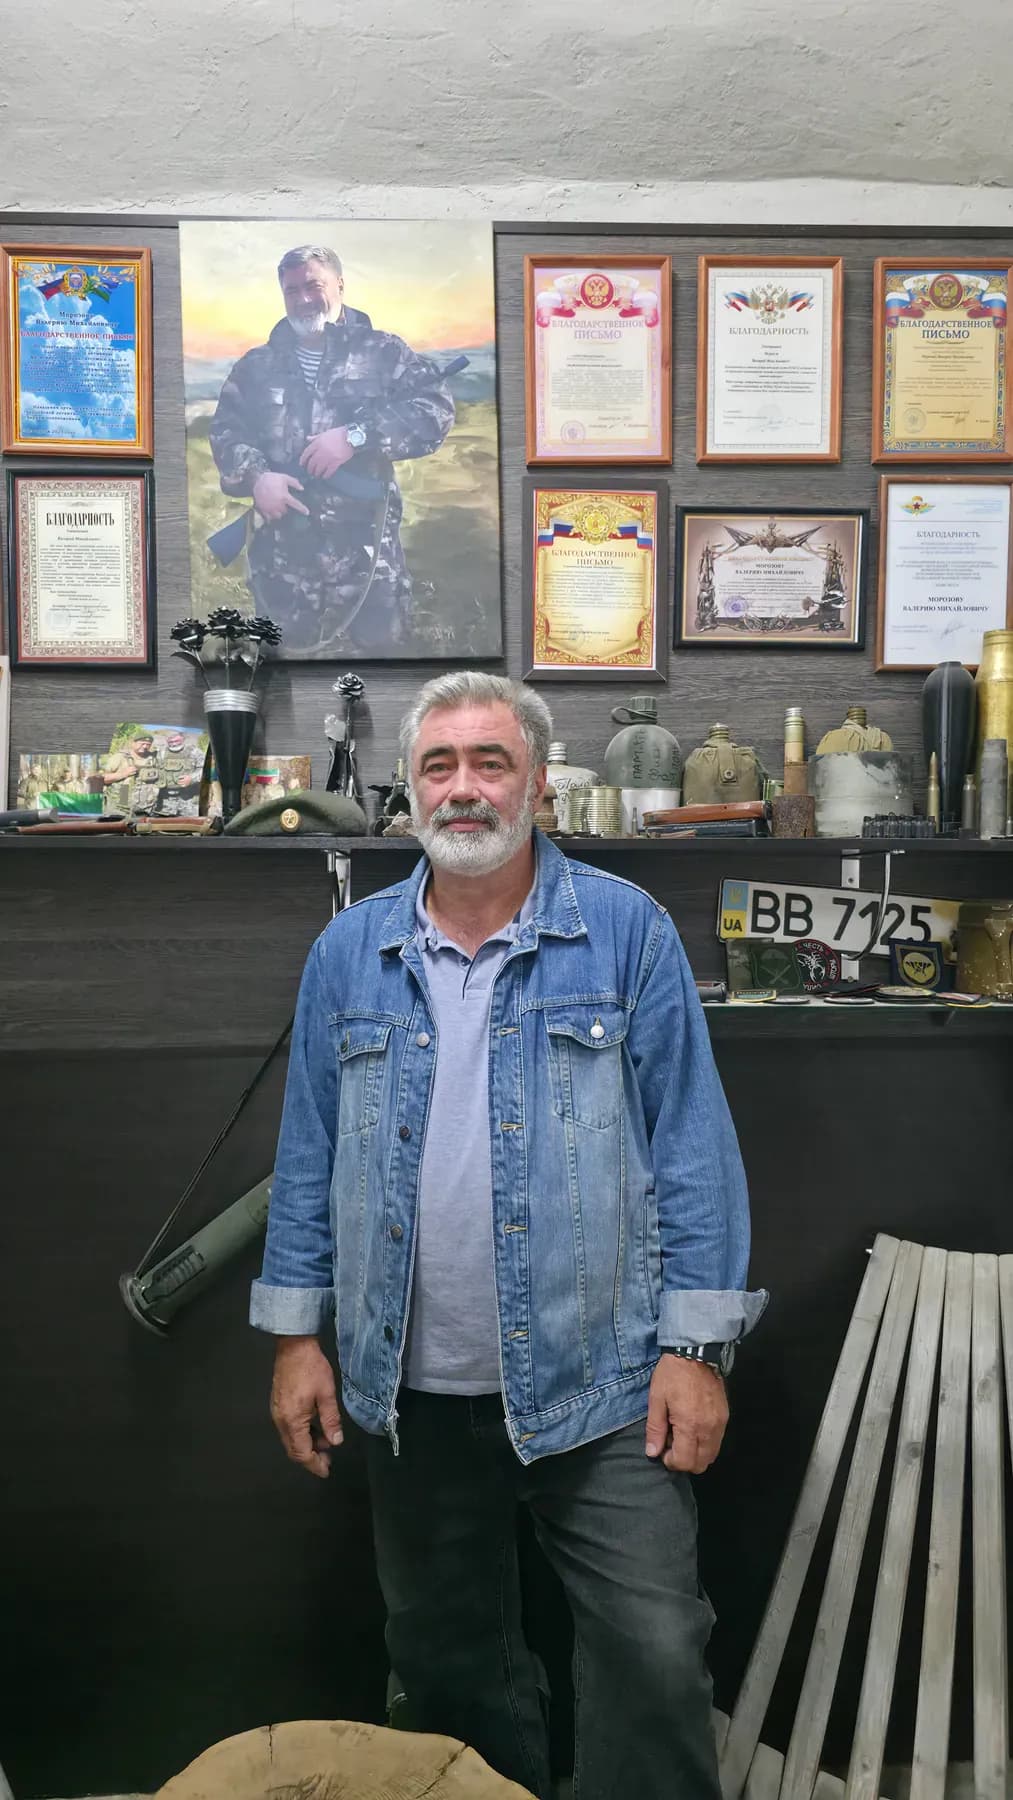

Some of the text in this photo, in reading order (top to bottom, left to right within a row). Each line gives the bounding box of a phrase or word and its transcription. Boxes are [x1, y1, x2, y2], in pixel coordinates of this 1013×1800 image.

[551, 319, 645, 329] БЛАГОДАРСТВЕННОЕ
[899, 319, 993, 329] БЛАГОДАРСТВЕННОЕ
[573, 329, 622, 340] ПИСЬМО
[728, 327, 809, 336] БЛАГОДАРНОСТЬ
[921, 329, 971, 339] ПИСЬМО
[46, 512, 115, 528] БЛАГОДАРНОСТЬ
[916, 531, 981, 539] БЛАГОДАРНОСТЬ
[551, 550, 638, 559] БЛАГОДАРСТВЕННОЕ
[750, 889, 932, 946] BB 7125
[723, 918, 743, 932] UA
